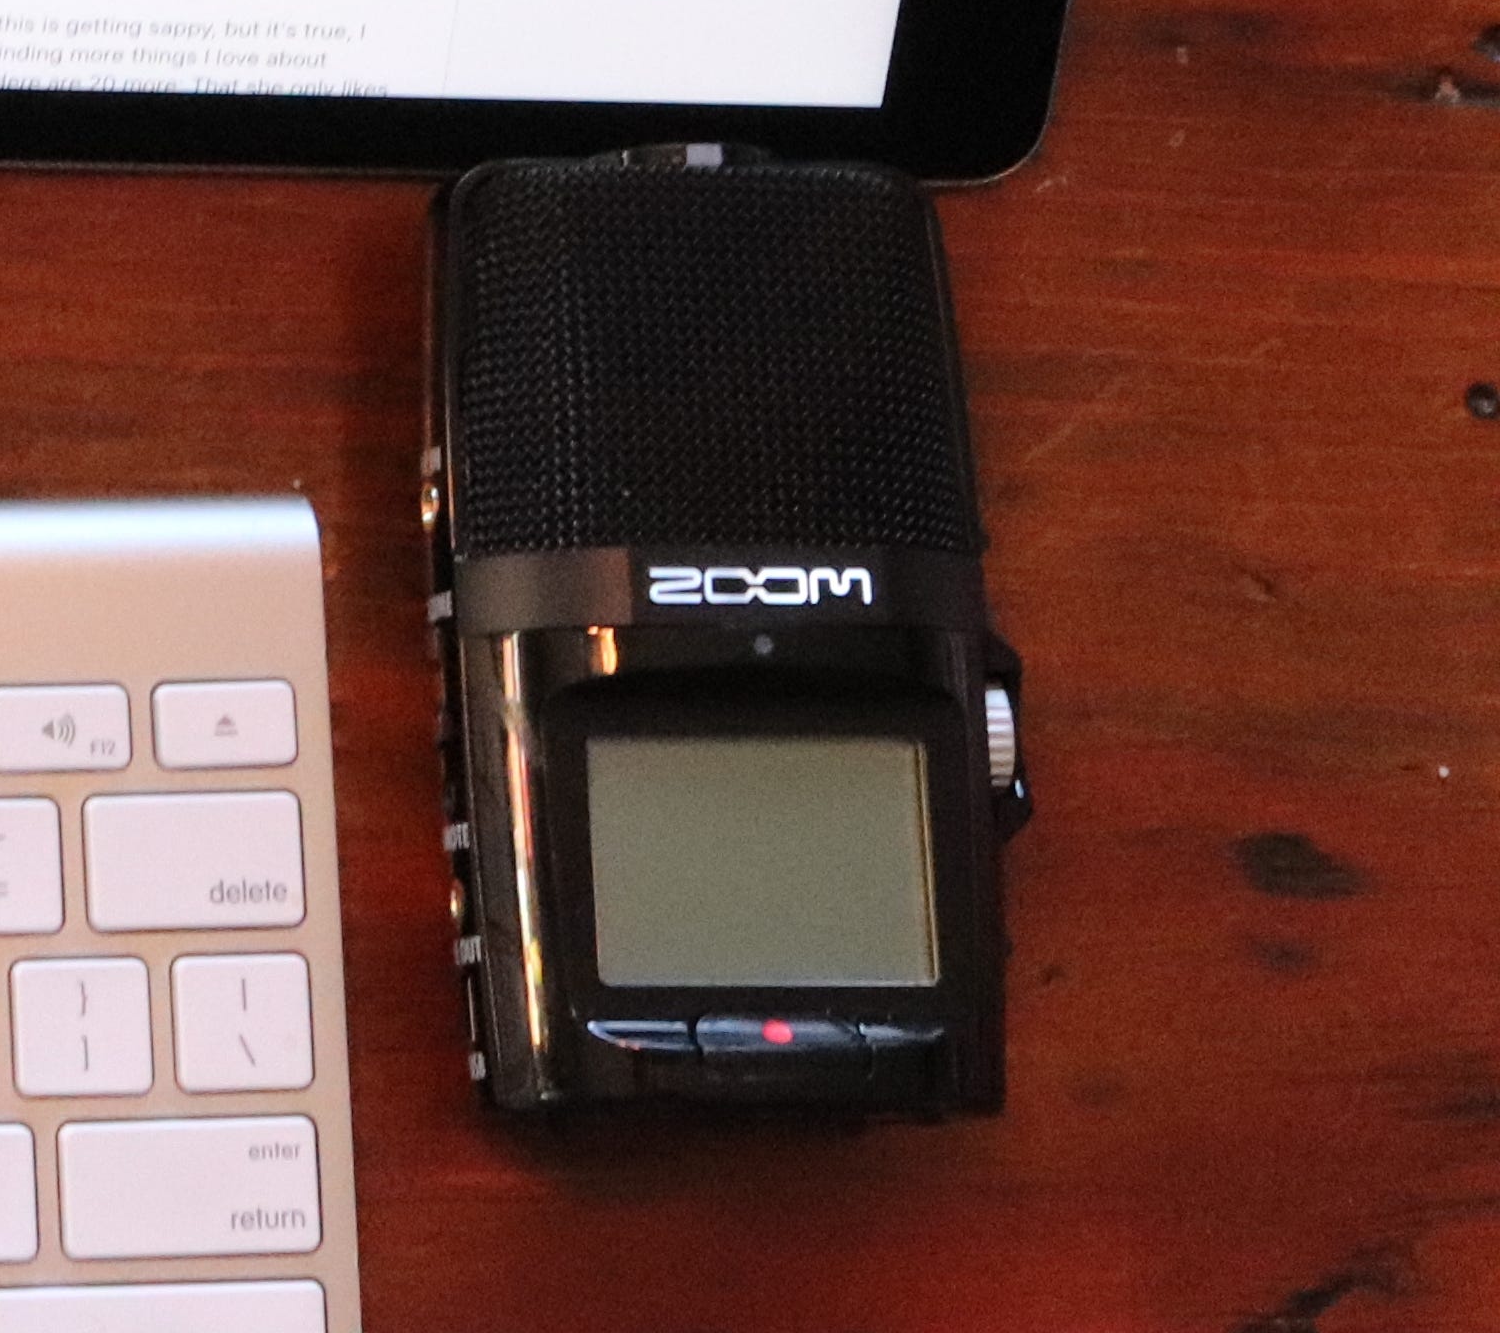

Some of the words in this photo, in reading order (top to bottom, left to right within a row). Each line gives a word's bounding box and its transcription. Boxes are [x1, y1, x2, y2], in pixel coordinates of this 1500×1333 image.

[649, 566, 873, 605] ZOOM
[208, 878, 288, 905] delete
[247, 1141, 301, 1161] enter
[230, 1207, 307, 1231] return
